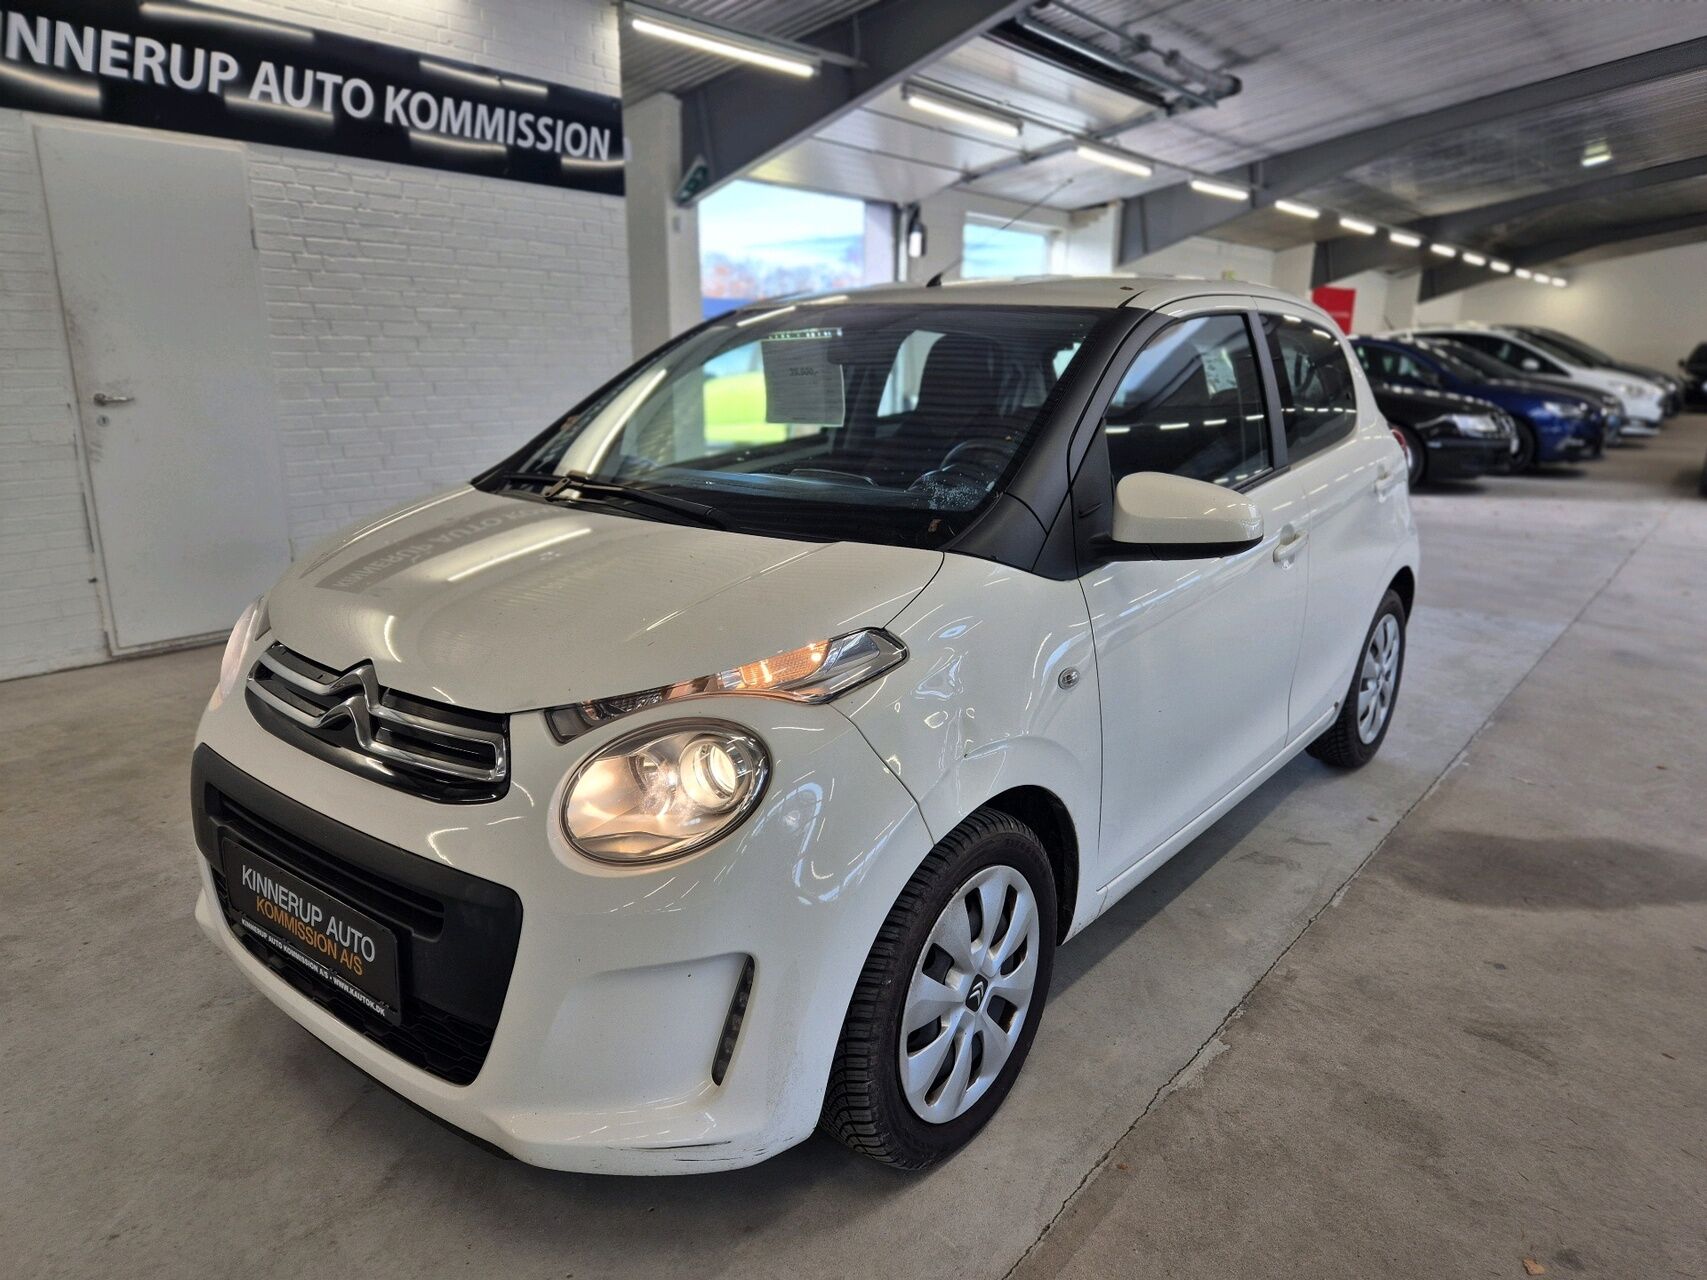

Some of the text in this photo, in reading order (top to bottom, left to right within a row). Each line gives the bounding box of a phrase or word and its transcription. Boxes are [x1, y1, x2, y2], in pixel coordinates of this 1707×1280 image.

[0, 10, 611, 162] NNERUP AUTO KOMMISSION
[242, 864, 375, 963] KINNERUP AUTO
[256, 896, 364, 976] KOMMISSION A/S
[268, 934, 283, 950] AUTO
